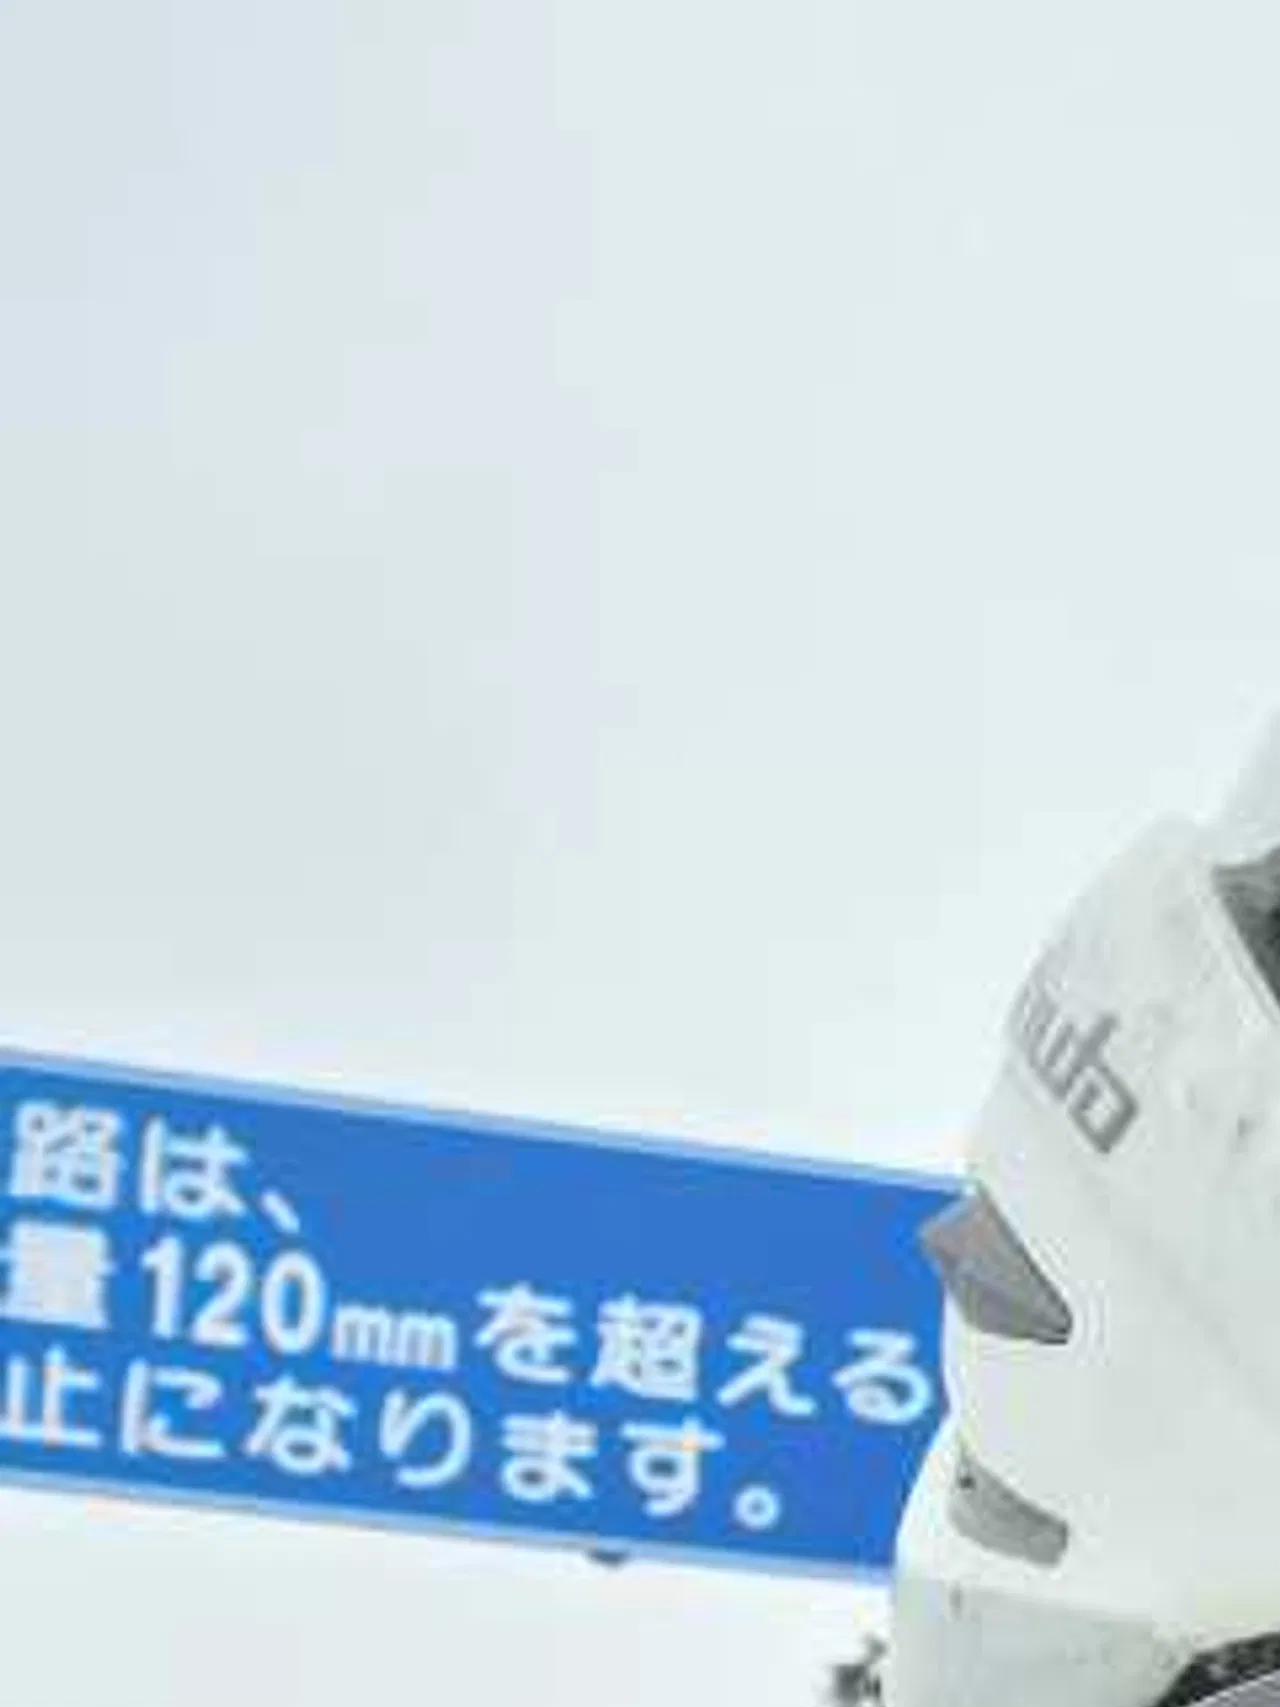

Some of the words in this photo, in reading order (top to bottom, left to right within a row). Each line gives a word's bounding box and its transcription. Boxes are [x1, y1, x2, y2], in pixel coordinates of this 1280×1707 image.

[9, 1097, 300, 1234] 路は、
[0, 1342, 781, 1531] 止になります。
